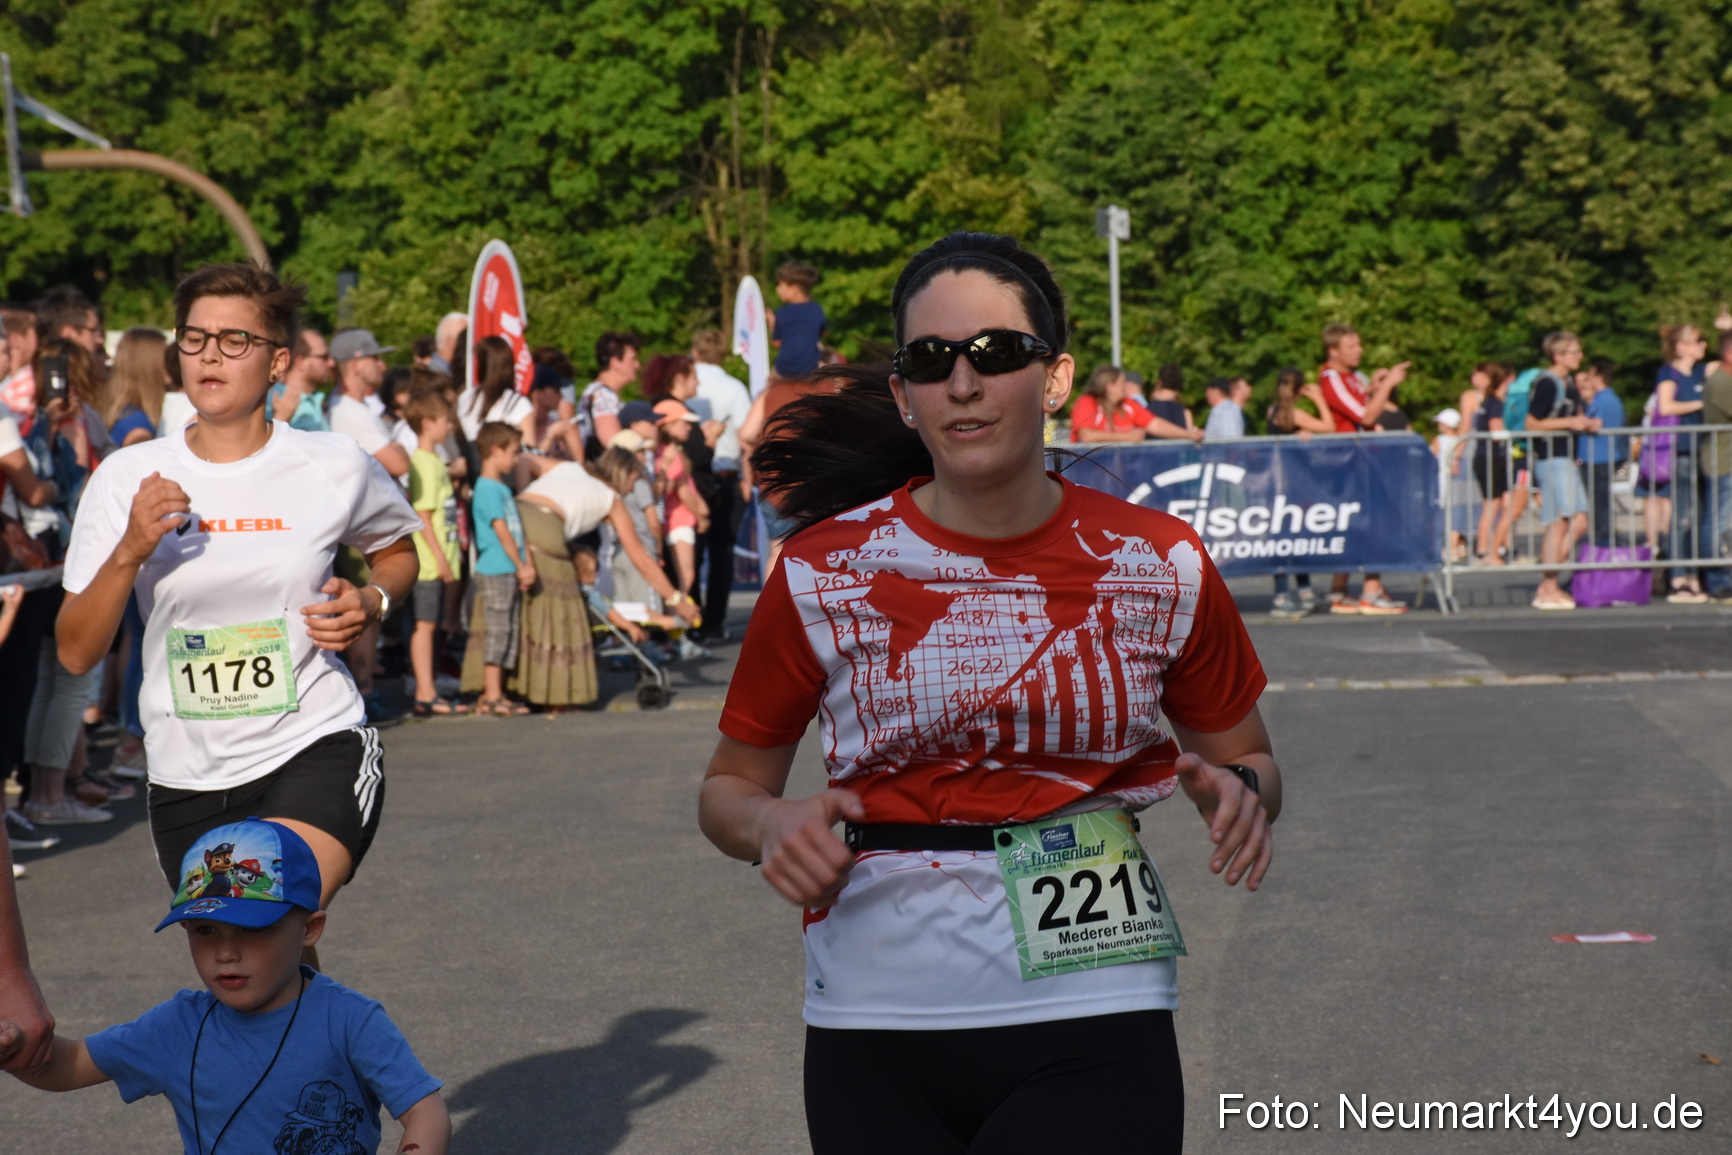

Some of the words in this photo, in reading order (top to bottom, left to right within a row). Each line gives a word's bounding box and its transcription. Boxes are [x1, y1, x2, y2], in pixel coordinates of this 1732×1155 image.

[198, 518, 292, 533] KLEBL
[1166, 494, 1361, 538] Fischer
[1204, 536, 1346, 559] UTOMOBILE
[933, 567, 987, 581] 10.54
[1110, 563, 1175, 578] 91.62%
[181, 656, 275, 694] 1178
[948, 657, 1004, 677] 26.22
[200, 695, 222, 705] Pruy
[224, 692, 259, 703] Nadine
[1031, 840, 1106, 866] firmenlauf
[1032, 862, 1163, 931] 2219
[1058, 924, 1118, 945] Mederer
[1121, 917, 1164, 934] Bianka
[1043, 944, 1095, 961] Sparkasse
[1096, 932, 1176, 952] Neumarkt-Parsberg
